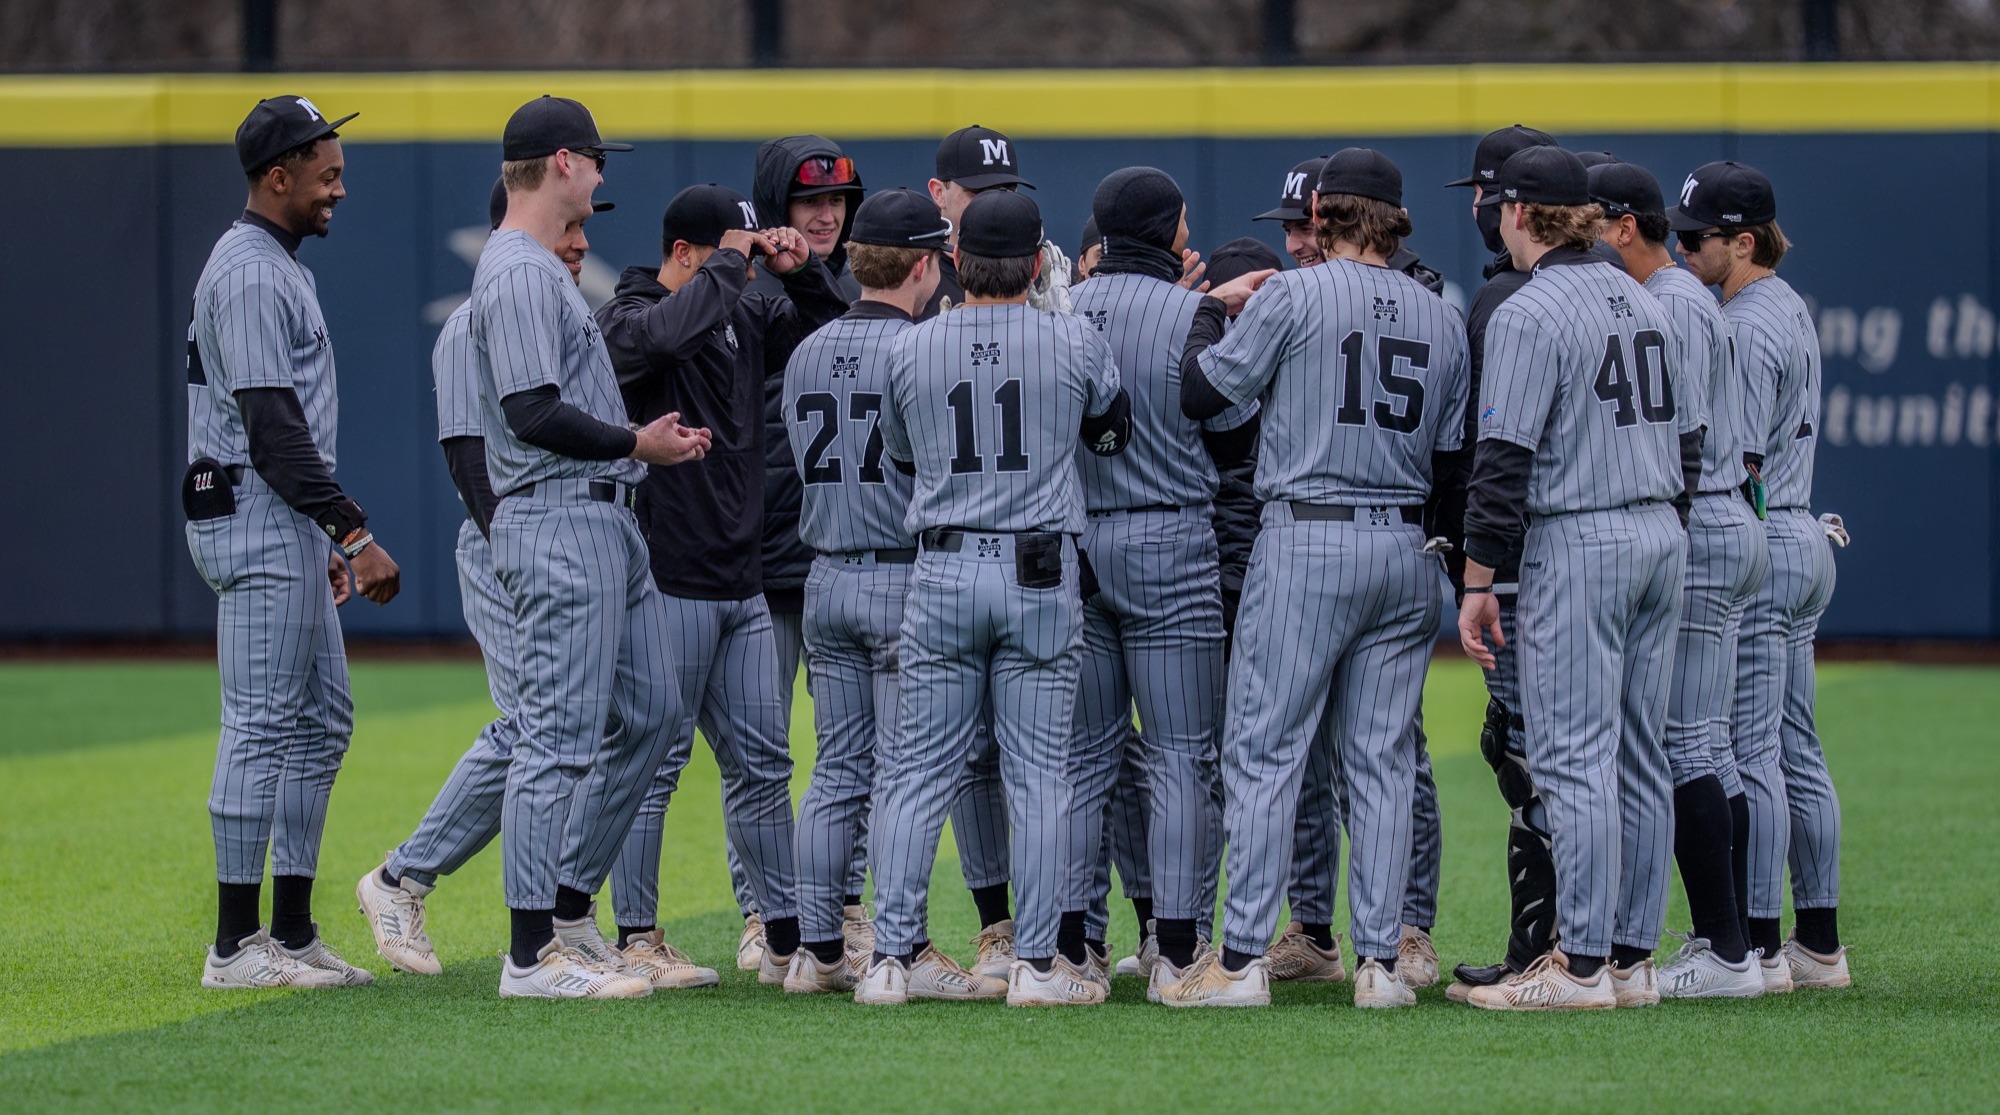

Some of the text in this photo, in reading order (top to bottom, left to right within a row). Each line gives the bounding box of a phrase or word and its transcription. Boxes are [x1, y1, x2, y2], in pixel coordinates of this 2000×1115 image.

[979, 138, 1011, 166] M
[1281, 171, 1308, 200] M
[1373, 296, 1398, 323] M
[1926, 291, 2000, 360] th
[831, 356, 860, 379] M
[970, 342, 1000, 367] M
[1336, 329, 1432, 436] 15
[1592, 328, 1677, 430] 40
[795, 391, 886, 486] 27
[946, 378, 1030, 477] 11
[1819, 383, 2000, 448] tunit
[977, 537, 1001, 558] M
